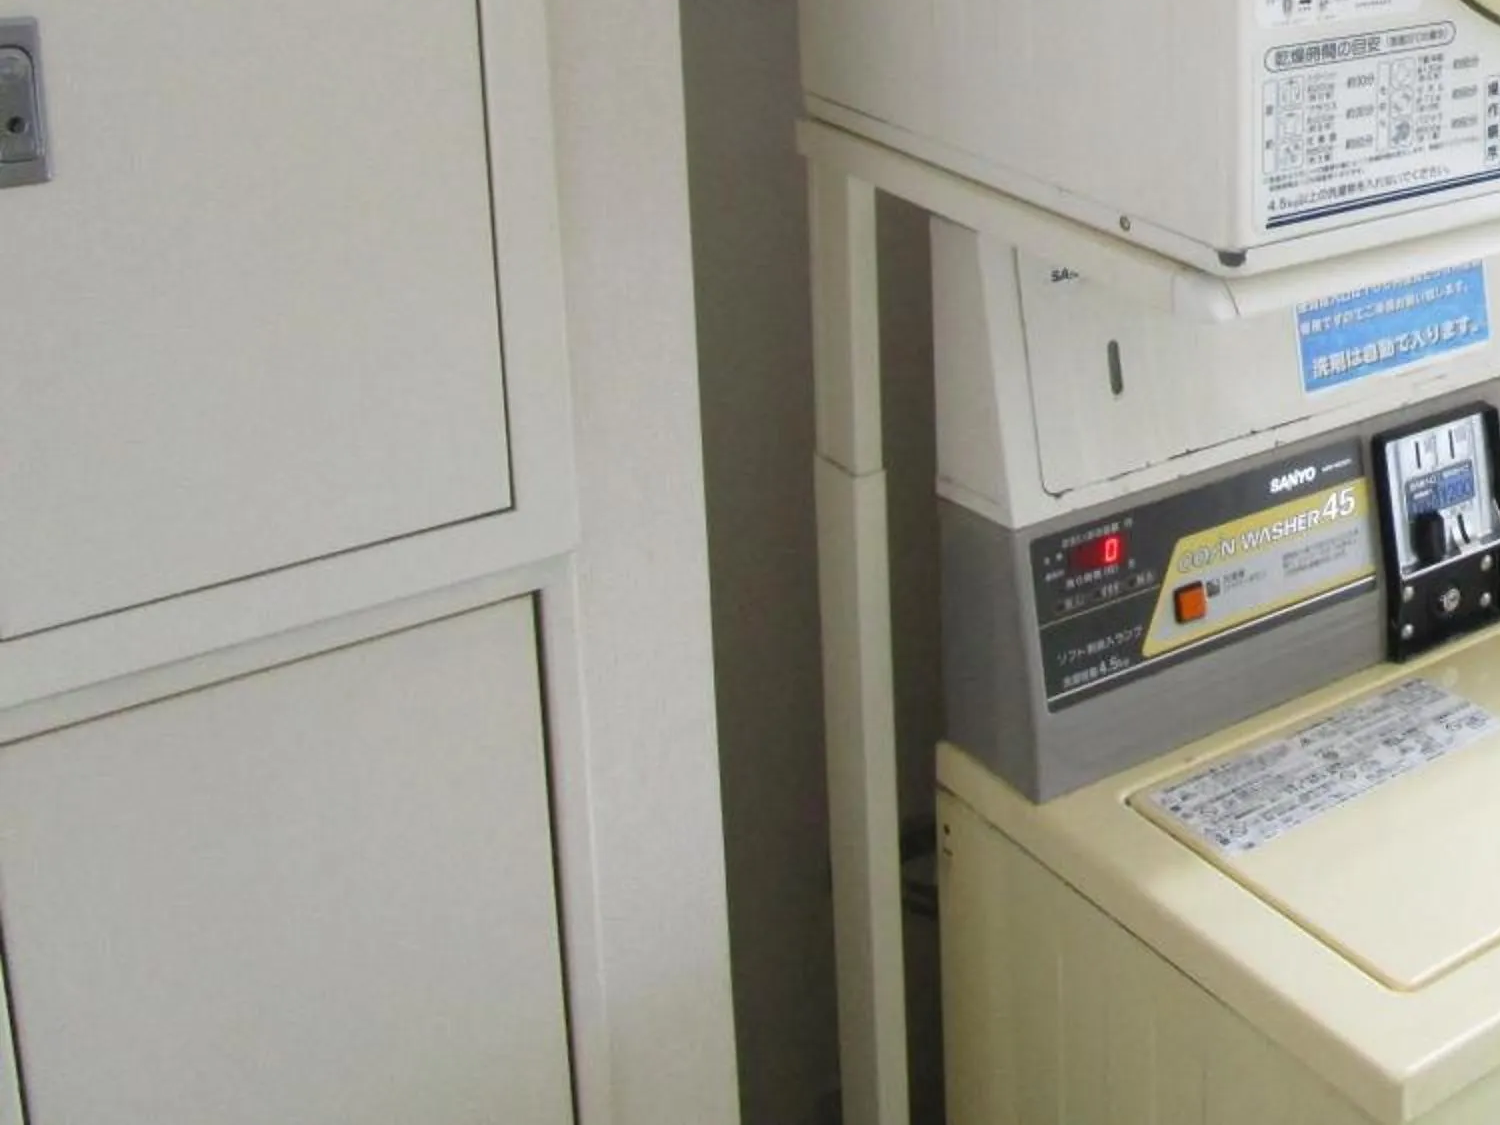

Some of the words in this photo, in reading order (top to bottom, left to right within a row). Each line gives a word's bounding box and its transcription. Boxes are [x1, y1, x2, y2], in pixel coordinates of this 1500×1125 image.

[1268, 465, 1317, 494] SANYO
[1240, 510, 1321, 551] WASHER
[1321, 487, 1356, 521] 45
[1104, 537, 1120, 563] 0
